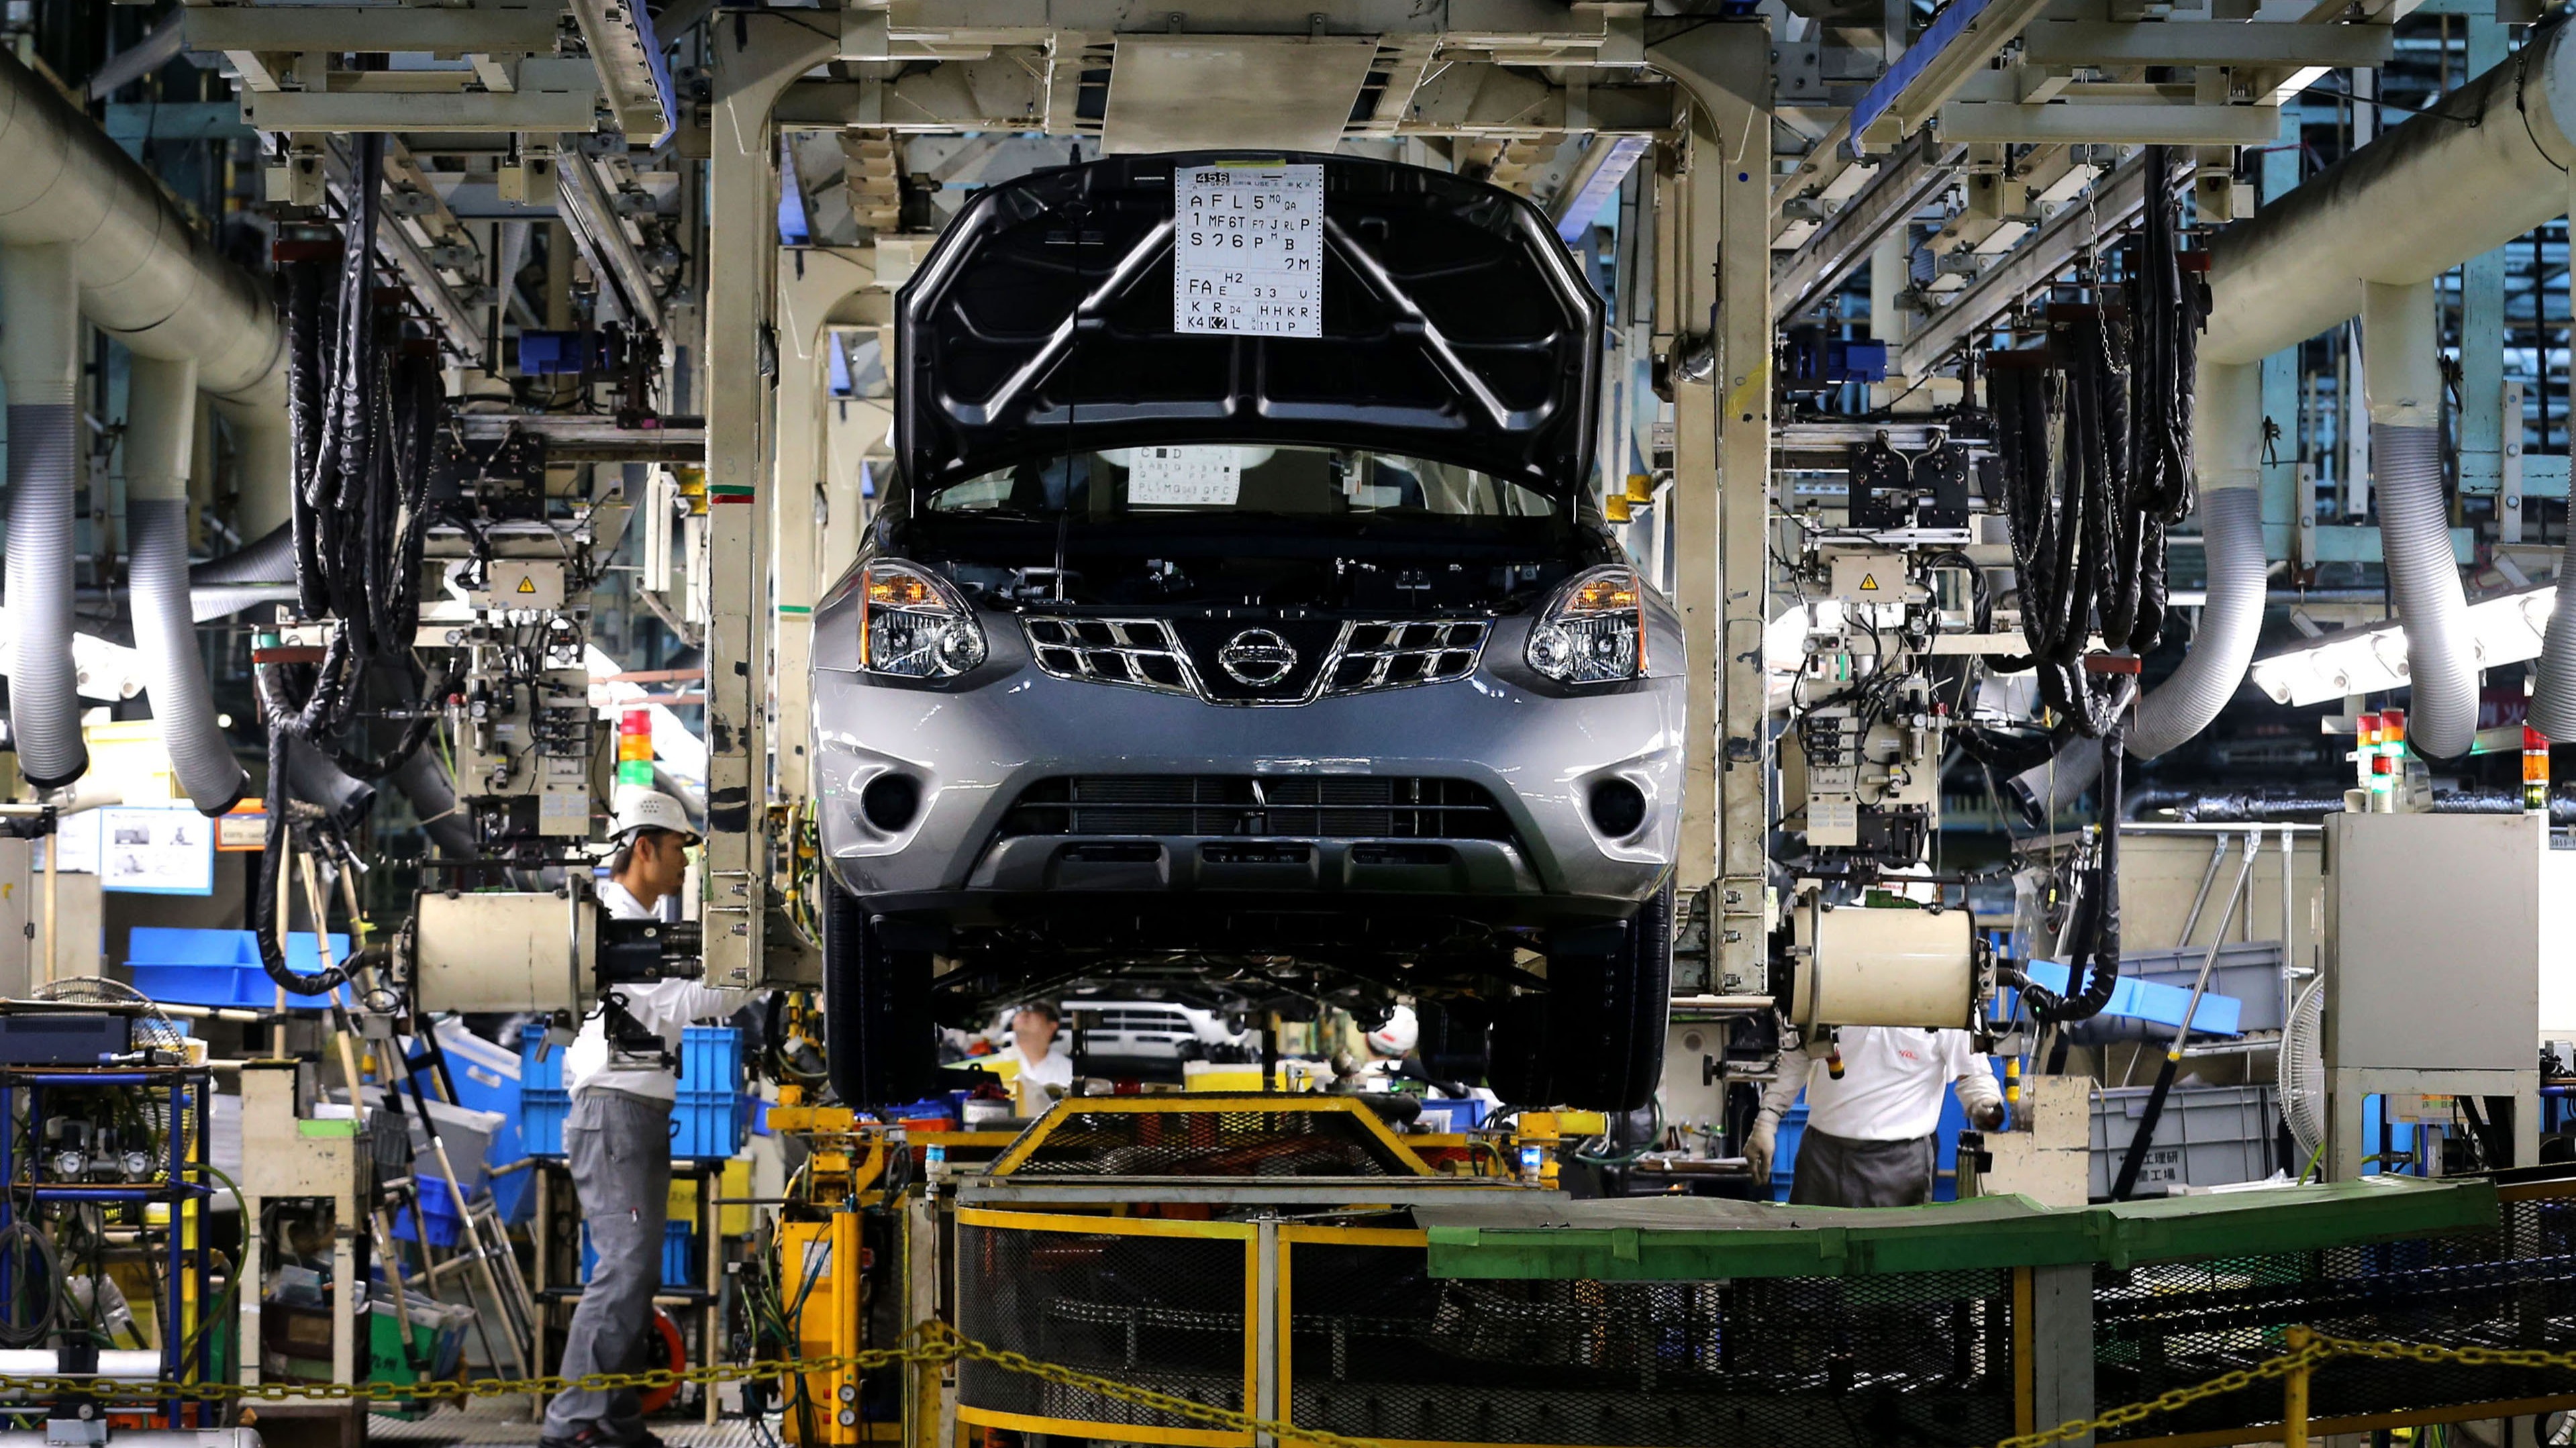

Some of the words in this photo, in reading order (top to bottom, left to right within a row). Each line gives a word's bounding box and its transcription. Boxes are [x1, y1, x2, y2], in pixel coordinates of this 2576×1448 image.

[1196, 172, 1229, 183] 456
[1191, 195, 1202, 207] A
[1212, 195, 1222, 207] F
[1234, 195, 1242, 209] L
[1254, 196, 1264, 209] 5
[1194, 213, 1199, 225] 1
[1209, 215, 1225, 227] MF
[1229, 217, 1245, 227] 6T
[1271, 220, 1277, 229] J
[1285, 221, 1294, 230] RL
[1301, 219, 1309, 230] P
[1191, 233, 1202, 246] S
[1232, 235, 1243, 248] 6
[1255, 238, 1262, 248] P
[1285, 239, 1293, 250] B
[1299, 259, 1309, 270] M
[1226, 273, 1242, 283] H2
[1190, 279, 1211, 294] FA
[1220, 287, 1226, 295] E
[1254, 288, 1260, 297] 3
[1270, 289, 1276, 297] 3
[1192, 301, 1199, 311] K
[1214, 303, 1221, 313] R
[1261, 306, 1268, 315] H
[1274, 307, 1281, 315] H
[1288, 307, 1294, 316] K
[1301, 307, 1307, 317] R
[1188, 317, 1203, 327] K4
[1209, 317, 1227, 329] K2
[1233, 319, 1239, 329] L
[1289, 323, 1295, 331] P
[1141, 448, 1150, 458] C
[1173, 449, 1181, 458] D
[1227, 648, 1287, 660] NISSAN
